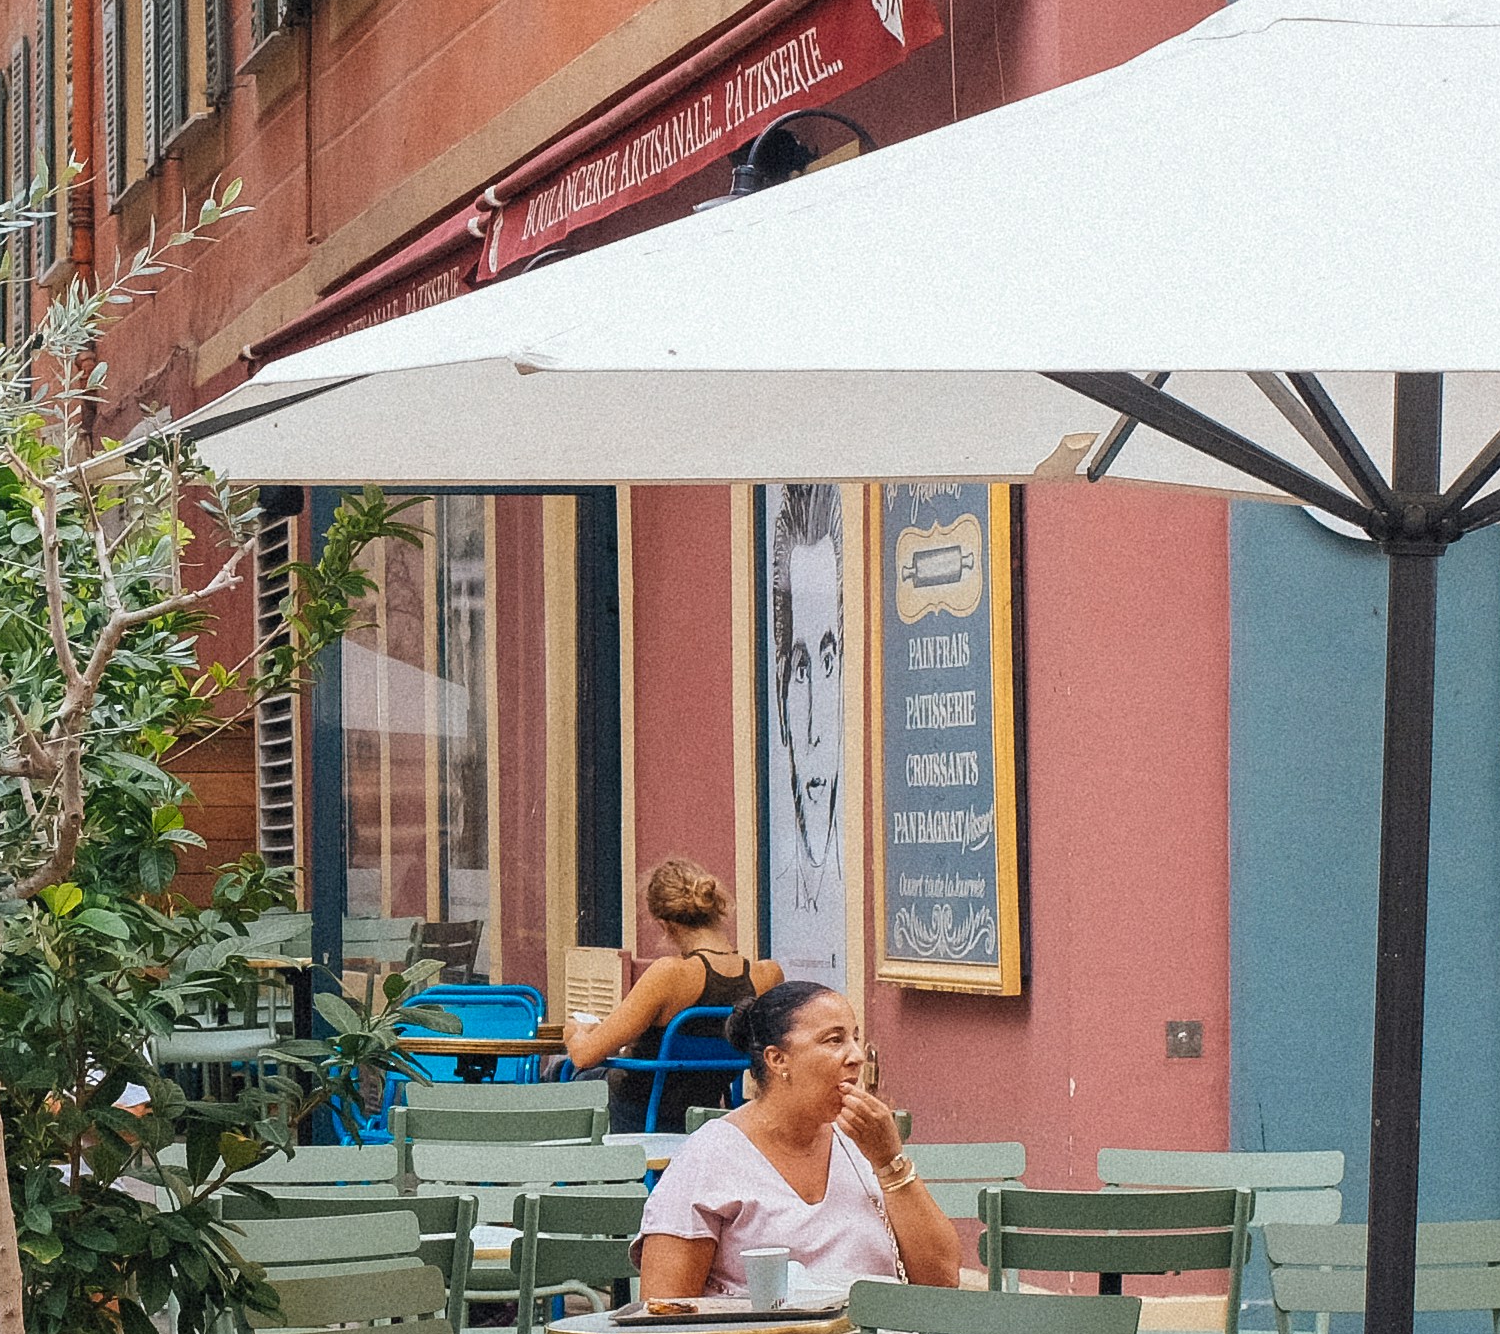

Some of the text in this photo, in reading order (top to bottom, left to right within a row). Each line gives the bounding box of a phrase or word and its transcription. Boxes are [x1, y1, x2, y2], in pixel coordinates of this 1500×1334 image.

[521, 151, 619, 241] BOULANGERIE
[908, 632, 970, 670] PAIN FRAIS
[906, 750, 979, 787] CROISSANTS
[893, 812, 917, 844] PAN
[917, 809, 964, 843] BAGNAT
